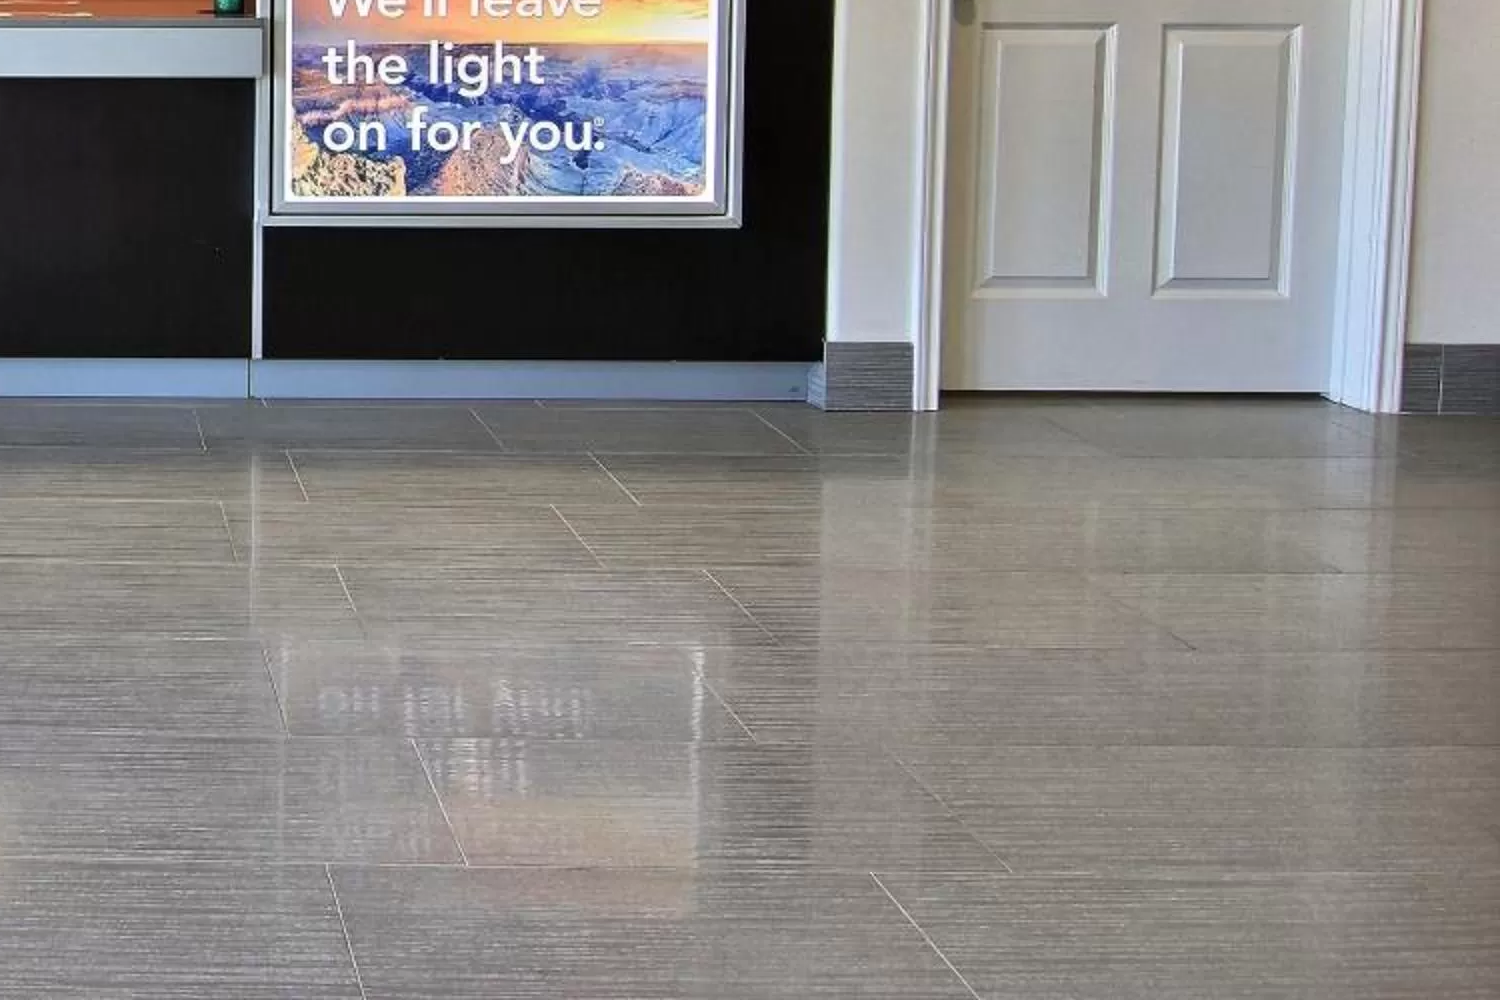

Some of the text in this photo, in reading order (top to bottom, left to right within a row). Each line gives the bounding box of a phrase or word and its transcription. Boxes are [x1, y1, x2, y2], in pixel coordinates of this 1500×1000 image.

[322, 39, 545, 97] the light
[322, 119, 386, 152] on
[406, 105, 480, 152] for
